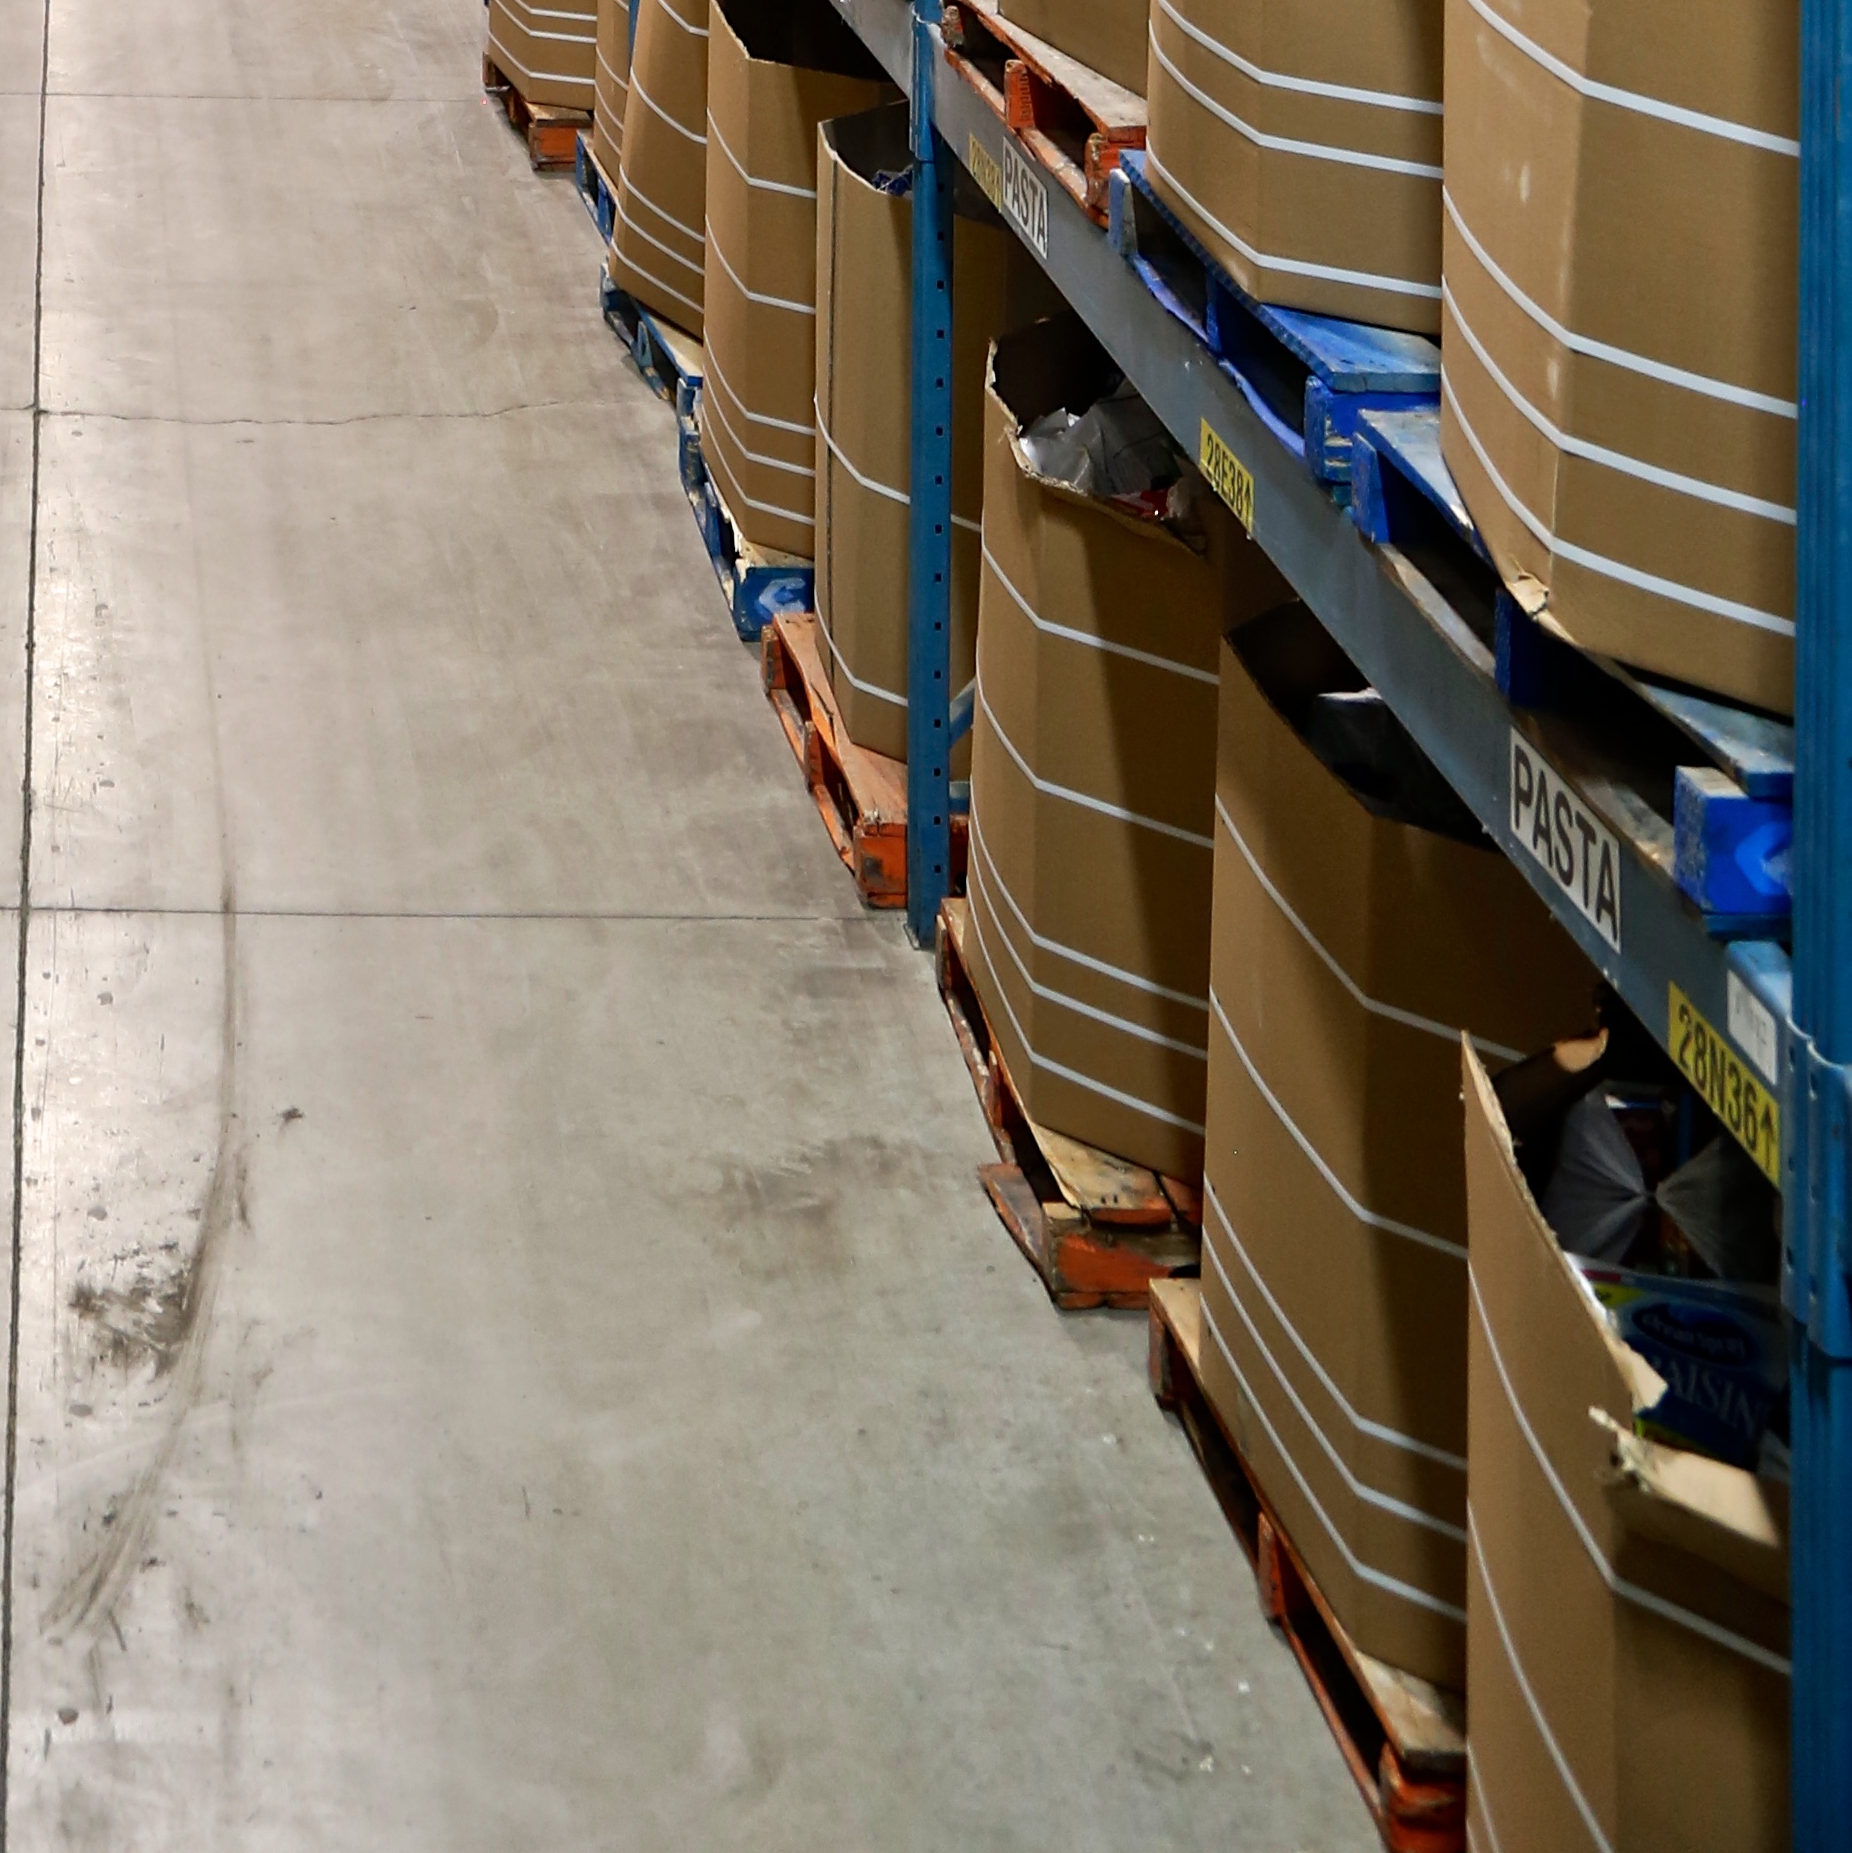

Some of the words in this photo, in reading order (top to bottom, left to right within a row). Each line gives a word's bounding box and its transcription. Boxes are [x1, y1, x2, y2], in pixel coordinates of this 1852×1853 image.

[1005, 144, 1047, 253] PASTA
[1514, 742, 1619, 942] PASTA
[1677, 1002, 1760, 1148] 28N36
